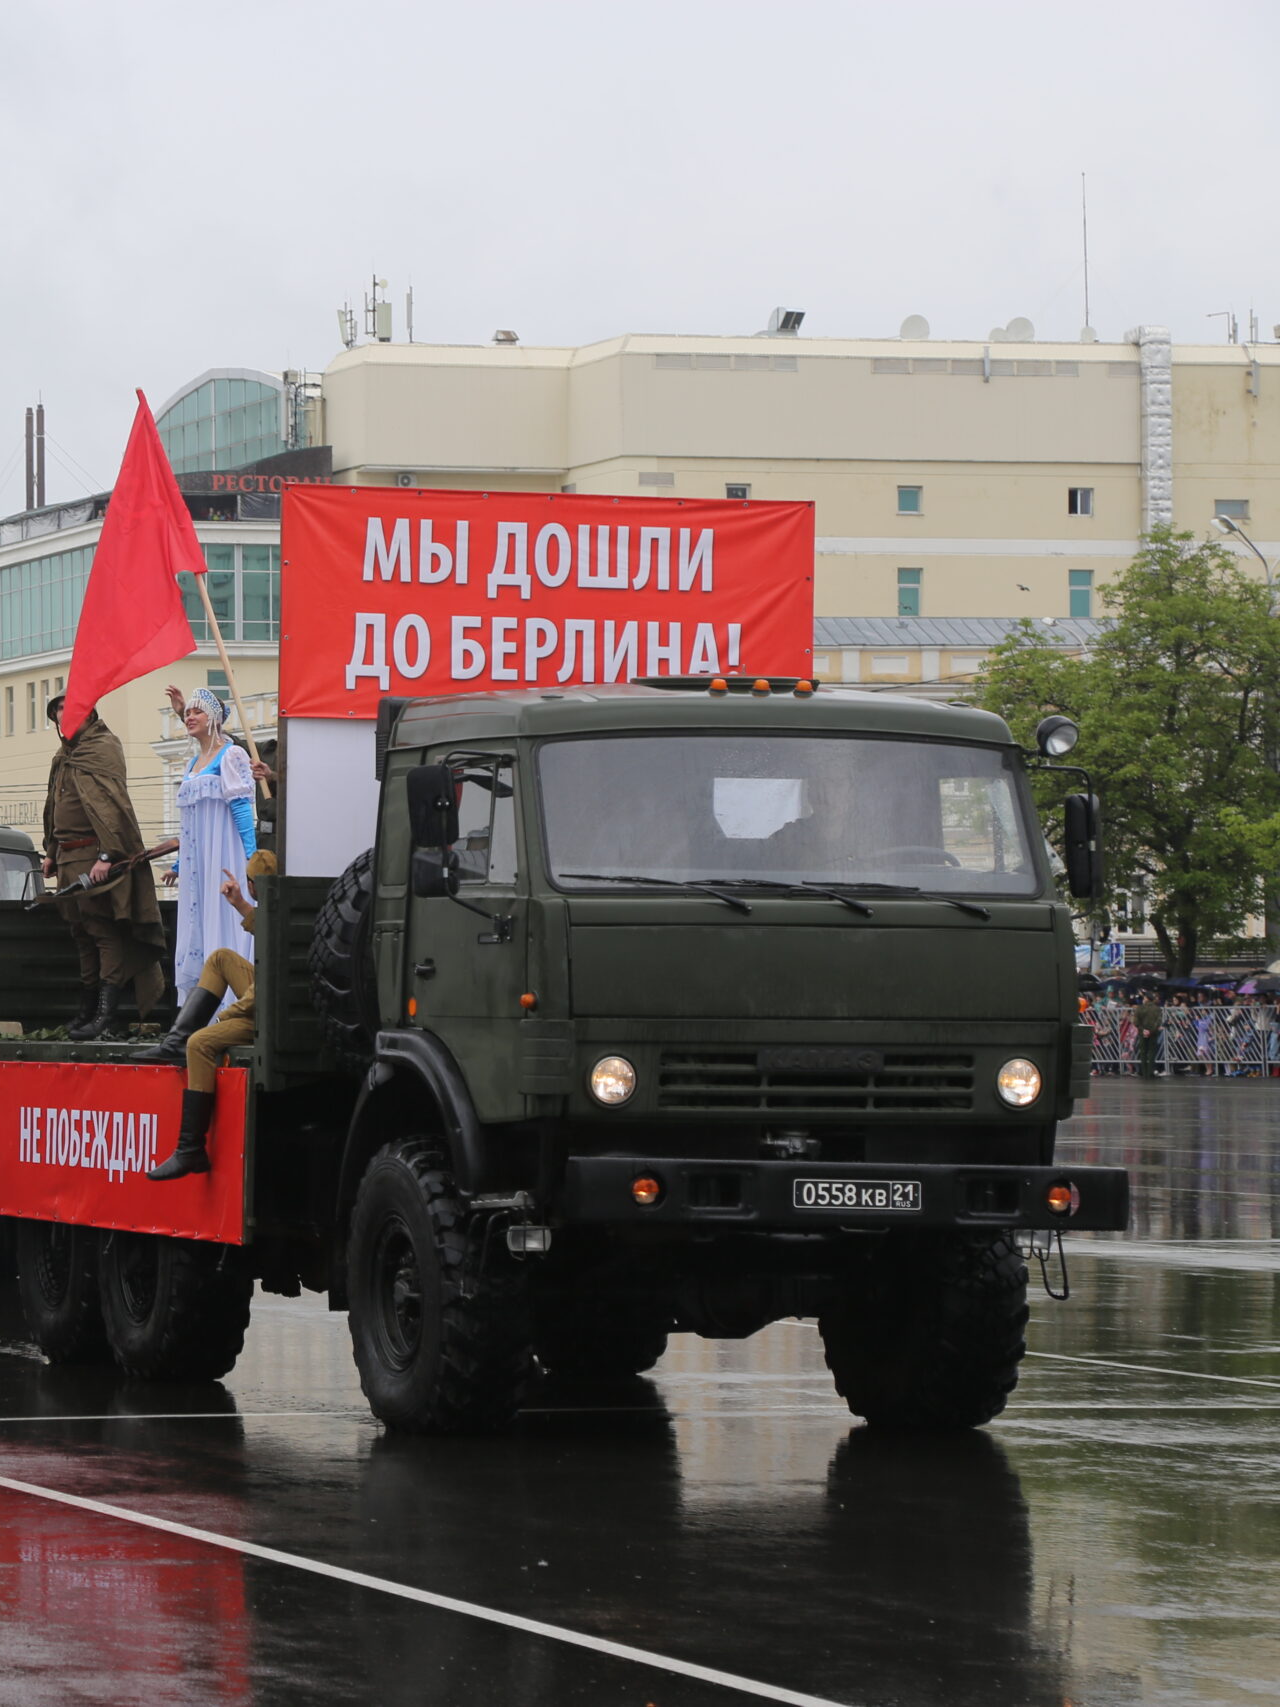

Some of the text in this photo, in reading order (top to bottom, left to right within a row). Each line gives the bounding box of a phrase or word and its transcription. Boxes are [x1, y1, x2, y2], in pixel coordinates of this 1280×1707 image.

[362, 516, 714, 600] МЫ ДОШЛИ
[345, 612, 742, 691] ДО БЕРЛИНА!
[19, 1106, 158, 1184] НЕ ПОБЕЖДАЛ!
[803, 1183, 857, 1205] 0558
[893, 1184, 914, 1201] 21
